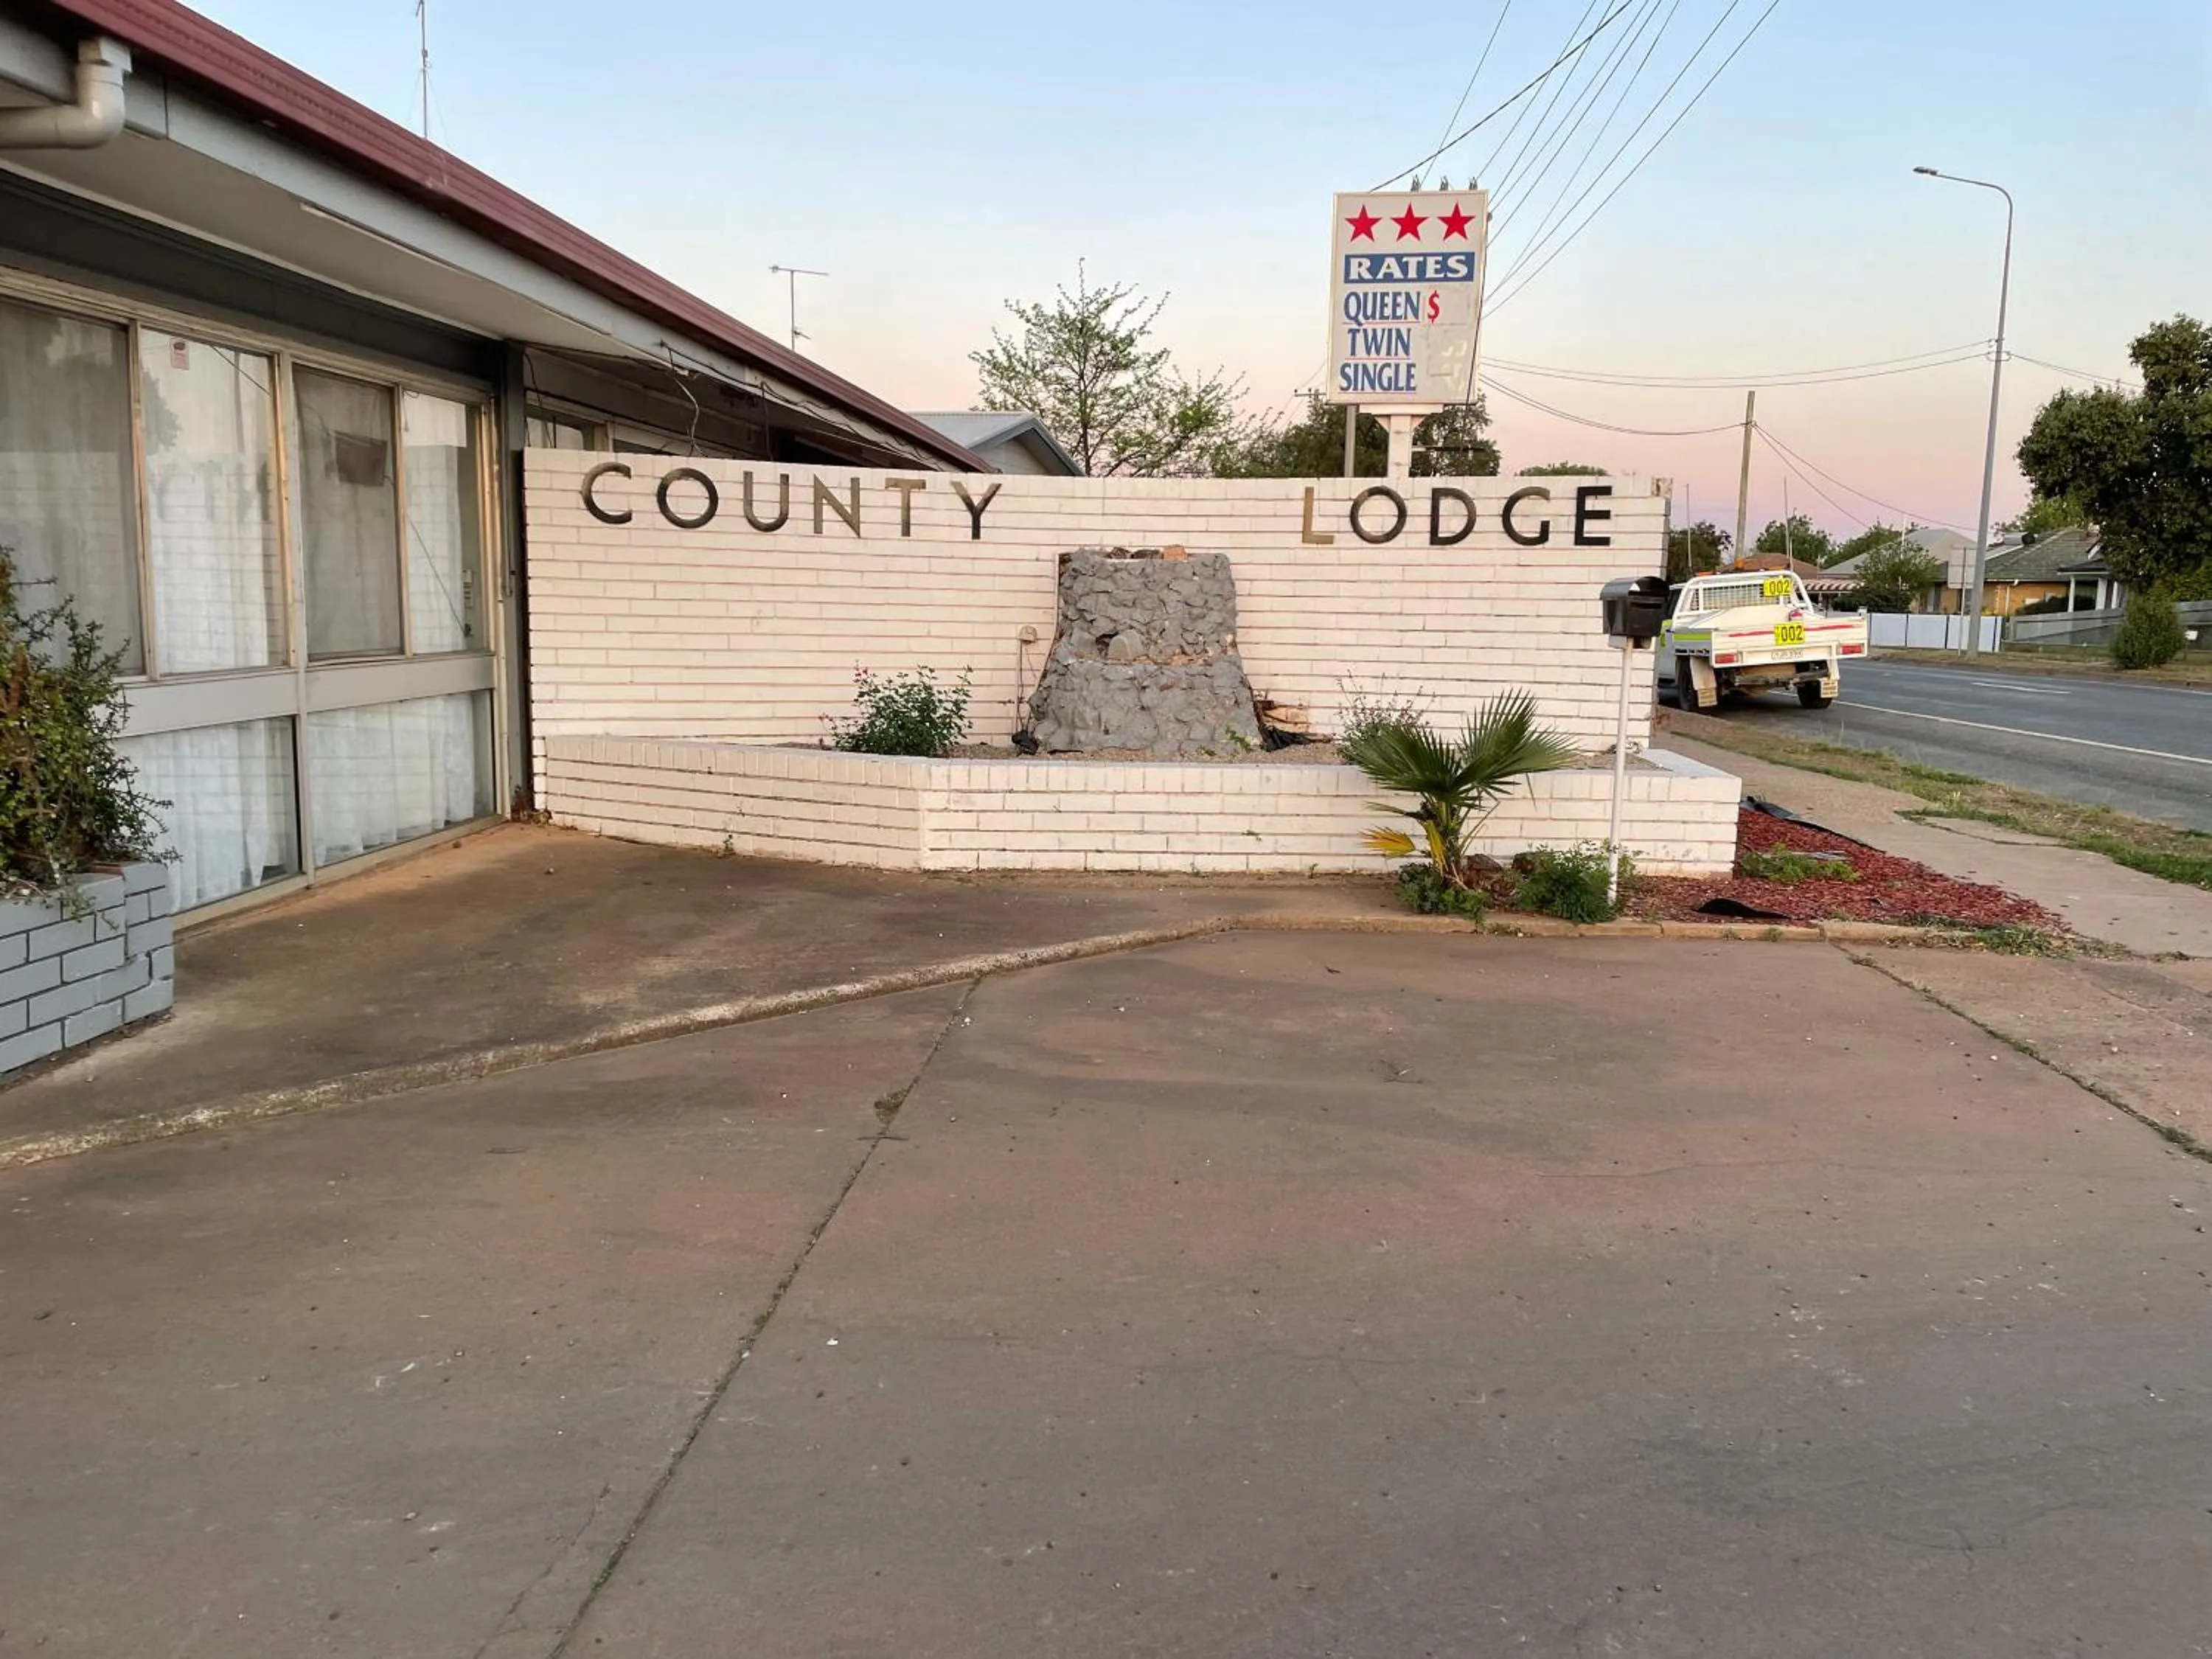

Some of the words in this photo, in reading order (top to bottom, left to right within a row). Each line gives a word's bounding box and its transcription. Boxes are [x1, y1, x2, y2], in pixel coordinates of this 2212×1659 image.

[1349, 255, 1468, 279] RATES
[1343, 291, 1421, 326] QUEEN
[1427, 290, 1440, 324] $
[1347, 328, 1411, 357] TWIN
[1339, 363, 1416, 392] SINGLE
[581, 462, 1001, 540] COUNTY
[1301, 485, 1613, 546] LODGE
[1769, 580, 1790, 595] 002
[1781, 625, 1803, 642] 002
